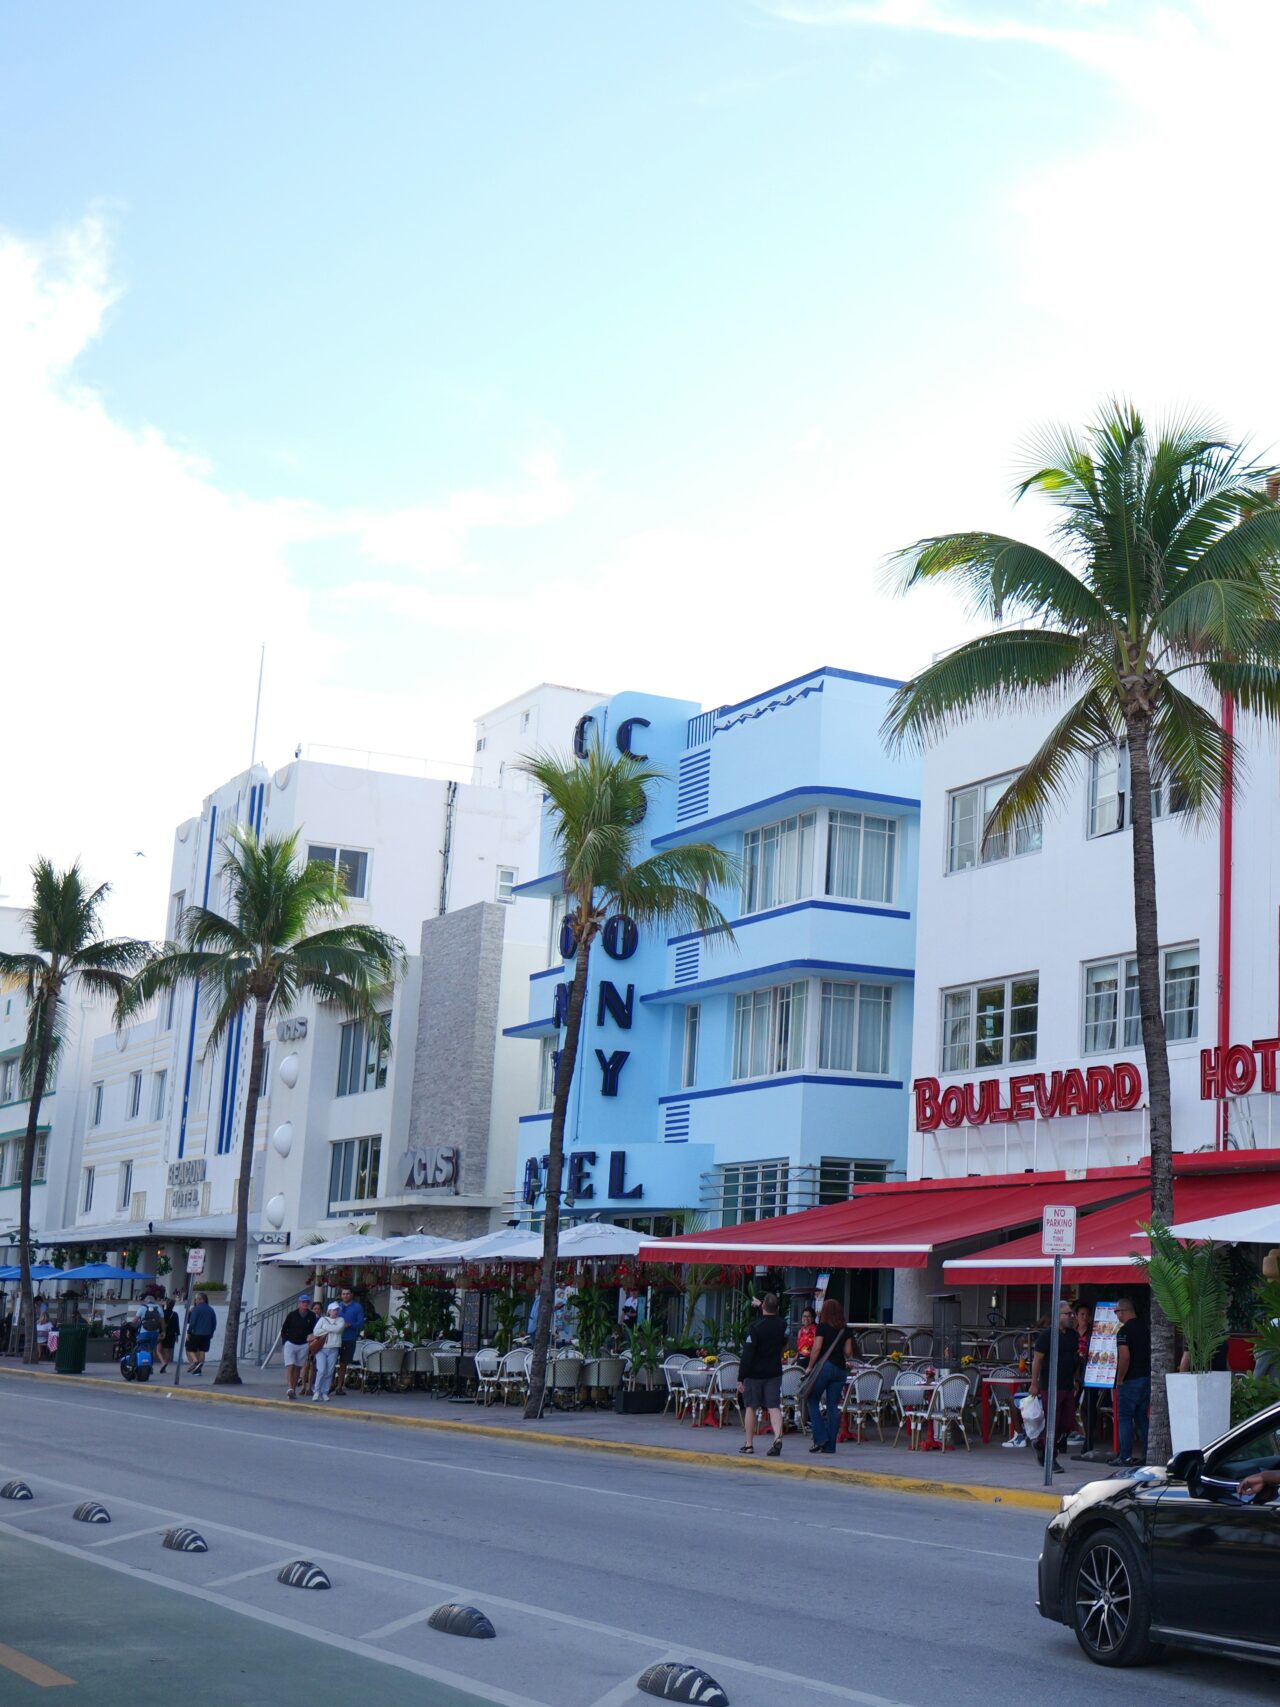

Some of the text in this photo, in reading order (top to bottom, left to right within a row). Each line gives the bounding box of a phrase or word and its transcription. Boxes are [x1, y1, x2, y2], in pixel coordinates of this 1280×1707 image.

[596, 717, 651, 1097] CONY
[914, 1062, 1142, 1132] BOULEVARD
[168, 1159, 206, 1186] BEACON
[414, 1147, 456, 1186] CVS
[172, 1188, 199, 1208] HOTEL
[1046, 1219, 1072, 1228] PARKING
[1053, 1209, 1066, 1218] NO
[263, 1233, 286, 1243] CVS
